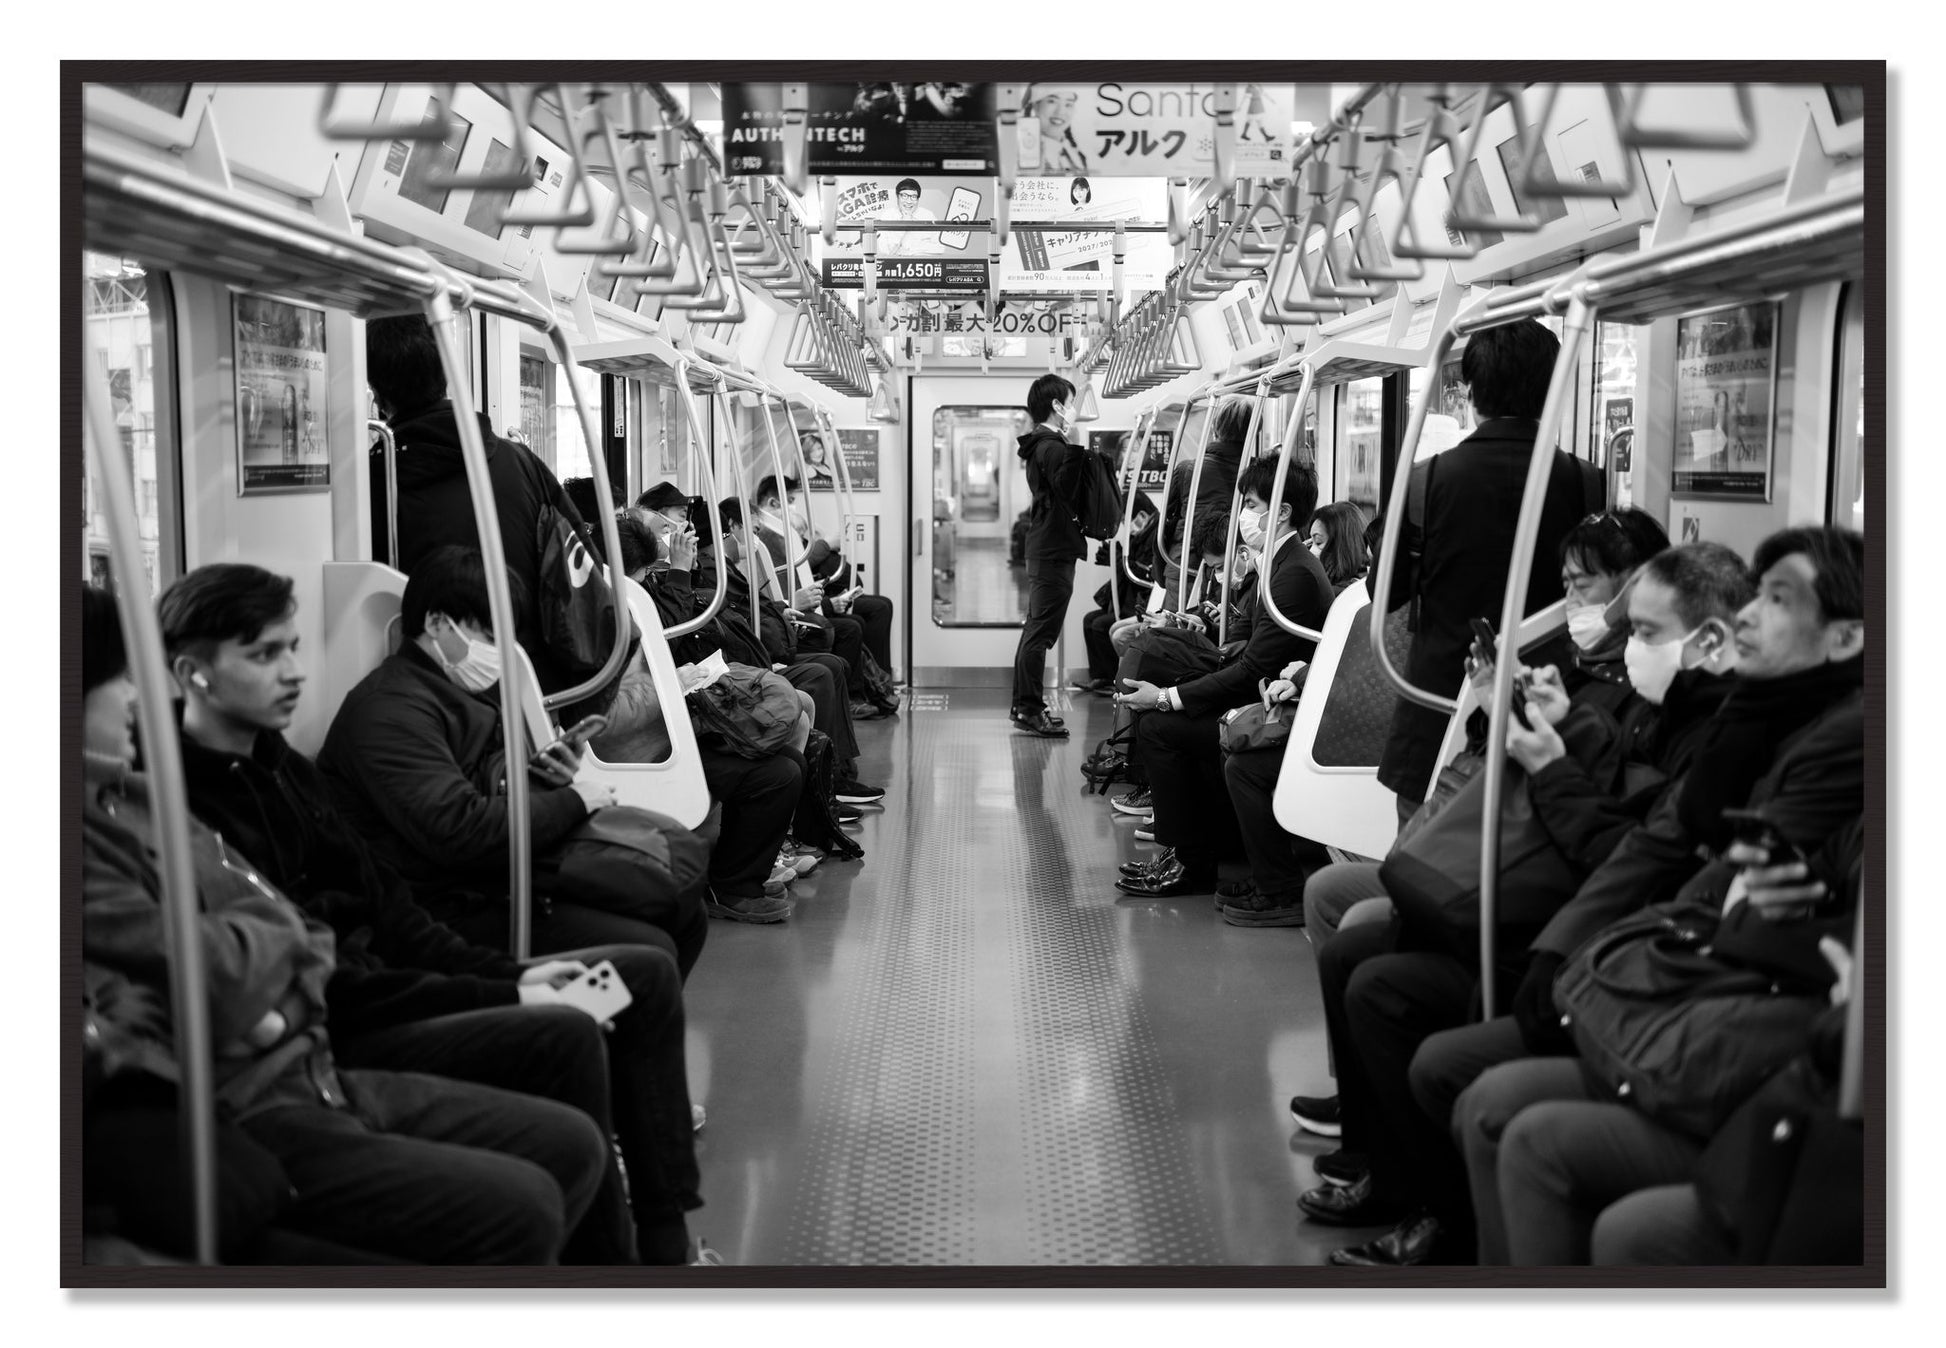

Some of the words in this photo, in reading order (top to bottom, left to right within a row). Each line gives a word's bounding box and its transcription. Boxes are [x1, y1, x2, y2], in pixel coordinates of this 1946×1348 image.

[1096, 130, 1186, 159] アルク
[1078, 239, 1113, 253] 2027/202
